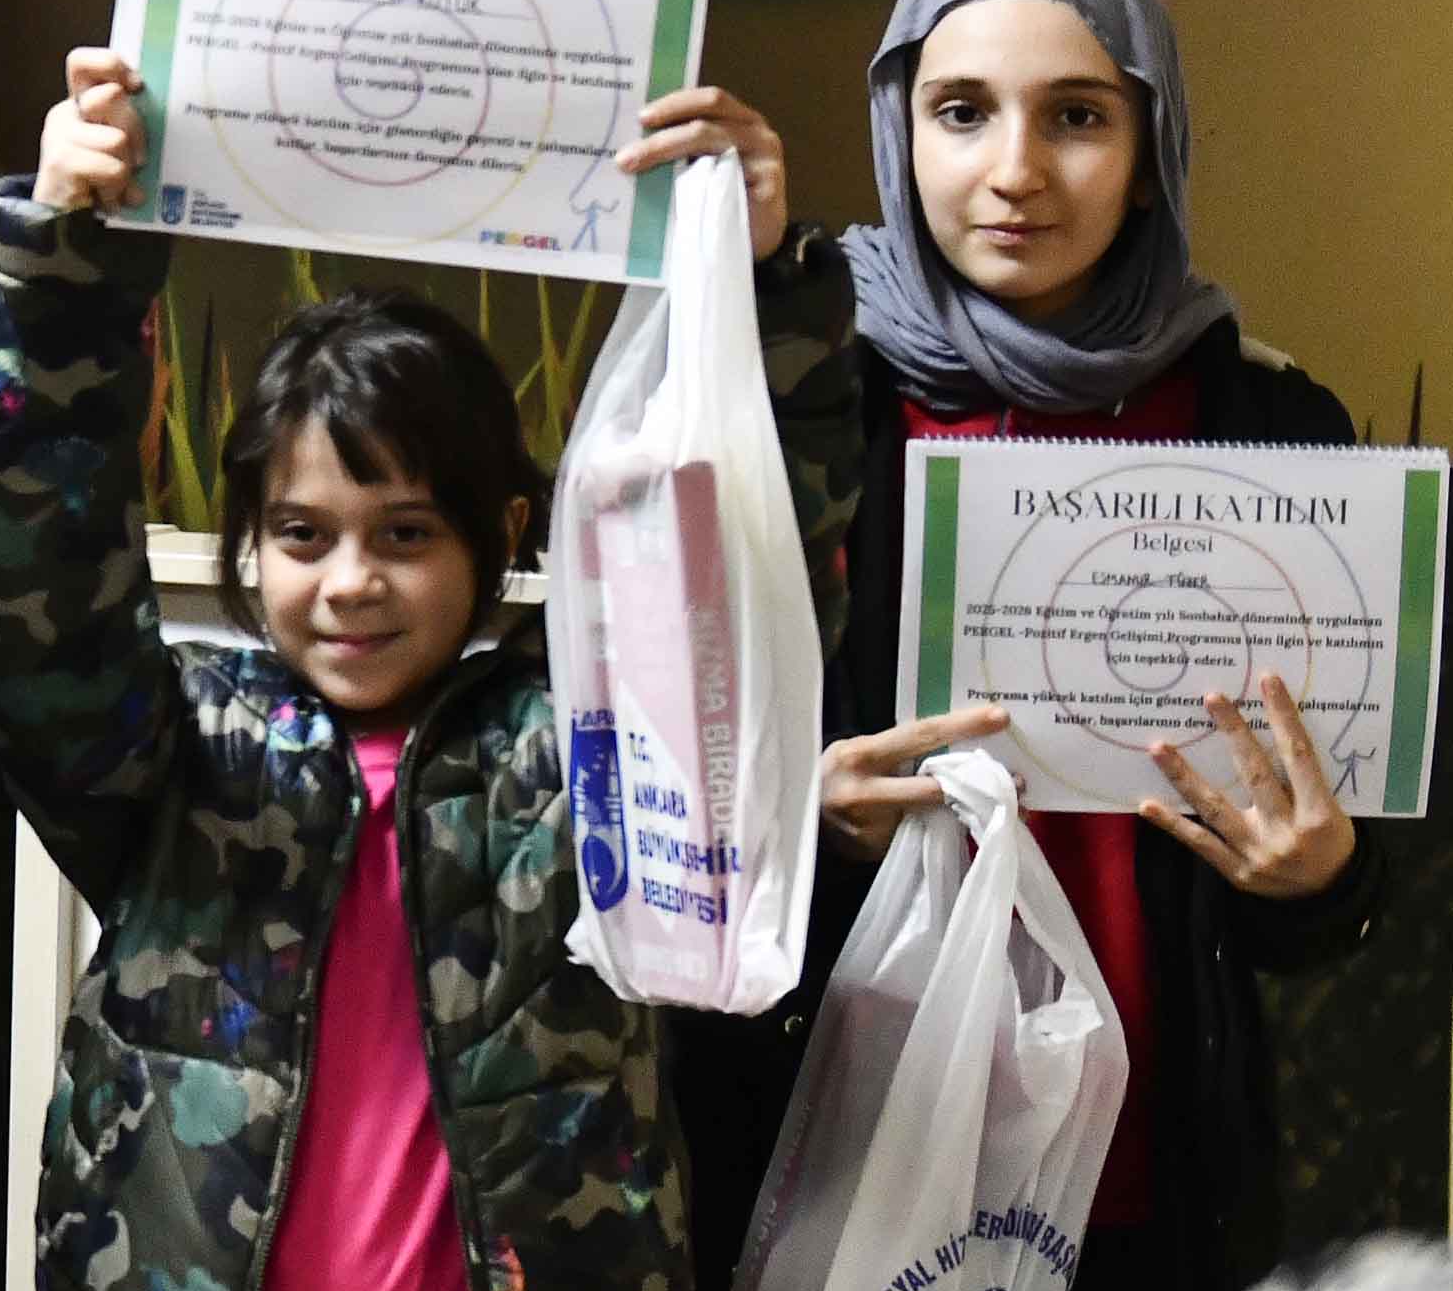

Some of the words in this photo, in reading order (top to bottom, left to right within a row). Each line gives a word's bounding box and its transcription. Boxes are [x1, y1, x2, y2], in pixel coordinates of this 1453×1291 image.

[1013, 487, 1184, 524] BAŞARILI
[1194, 493, 1348, 526] KATILIM
[1132, 531, 1213, 557] Belgesi
